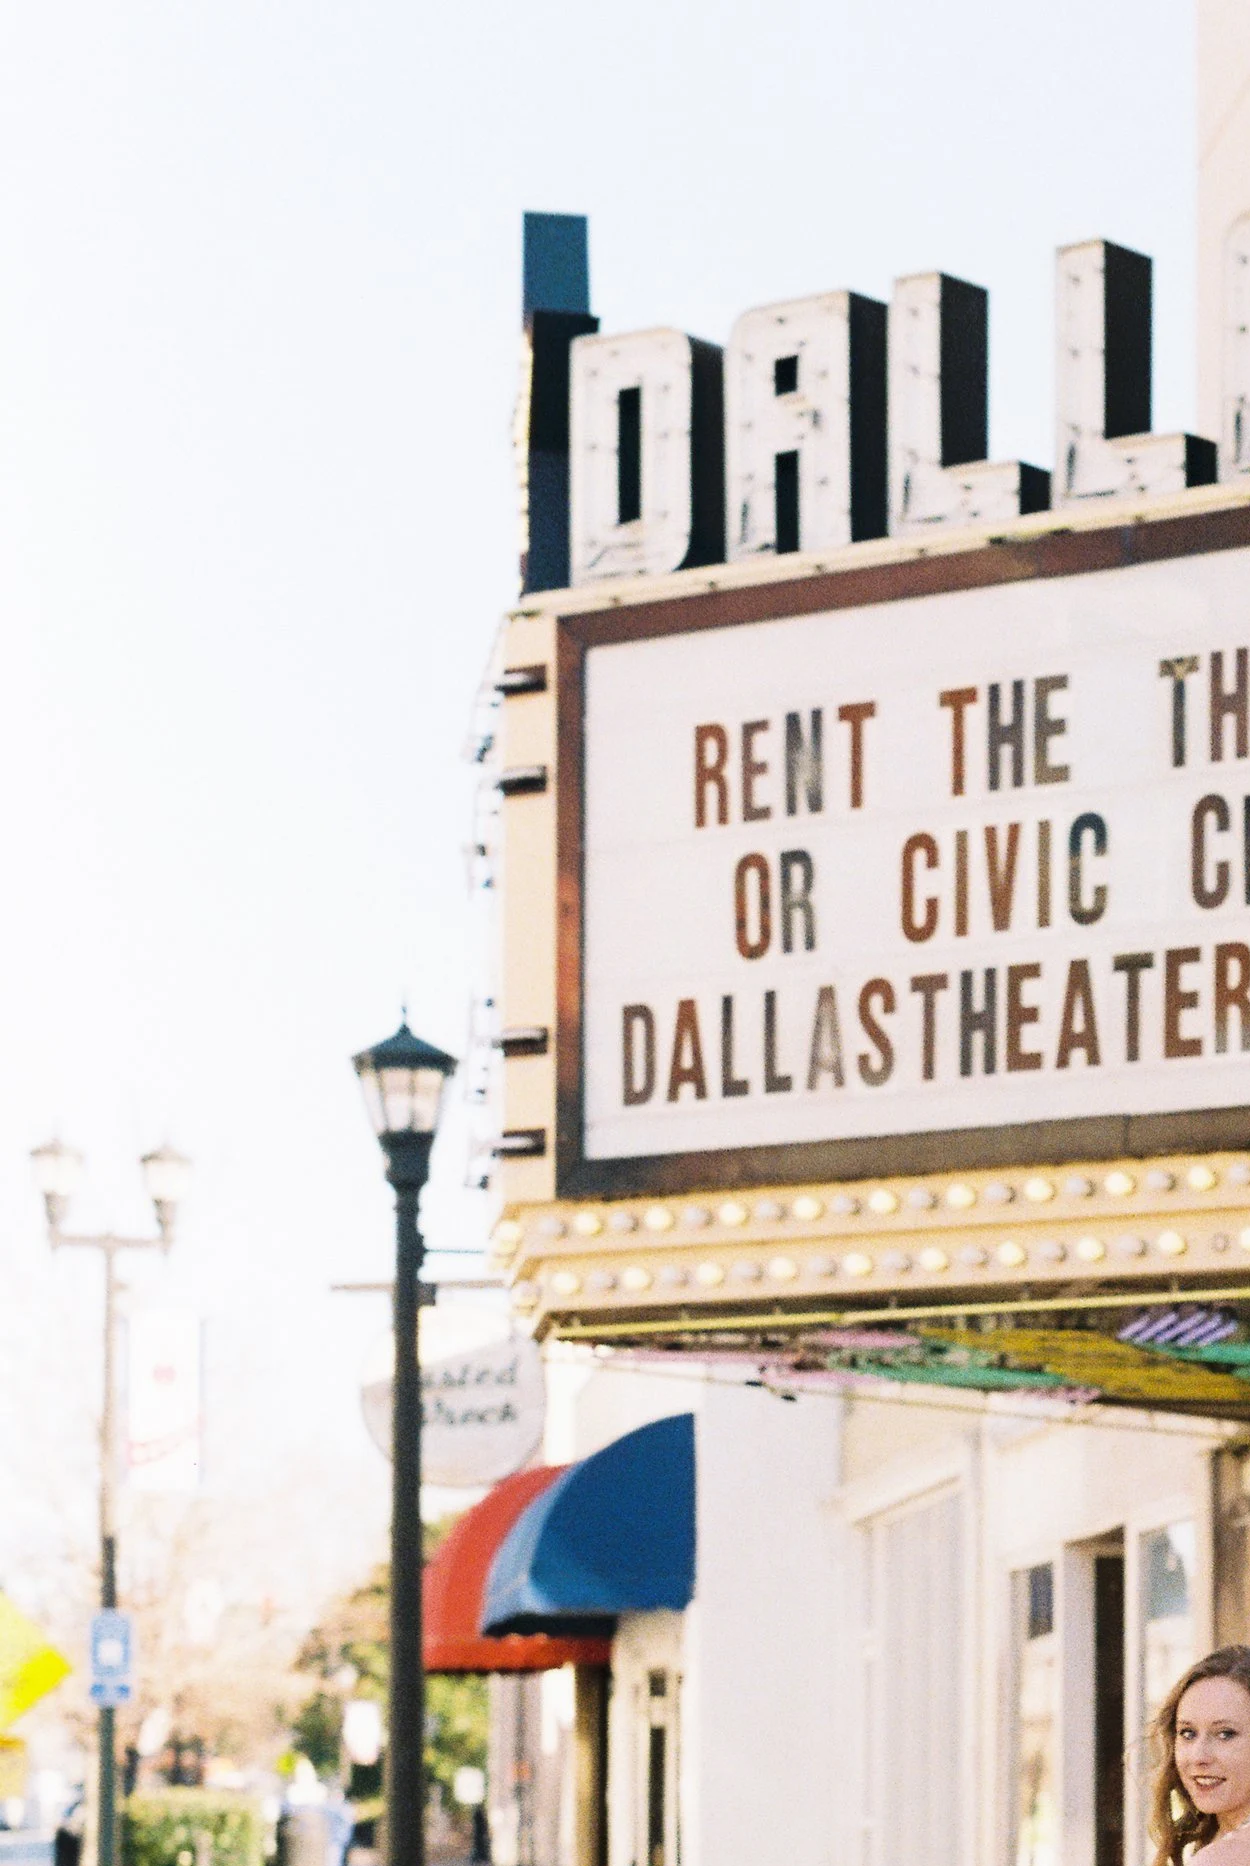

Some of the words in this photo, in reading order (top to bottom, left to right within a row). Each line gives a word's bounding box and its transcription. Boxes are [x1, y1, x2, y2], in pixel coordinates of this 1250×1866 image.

[694, 702, 875, 827] RENT
[939, 674, 1069, 795] THE
[735, 849, 817, 960] OR
[901, 812, 1109, 943] CIVIC
